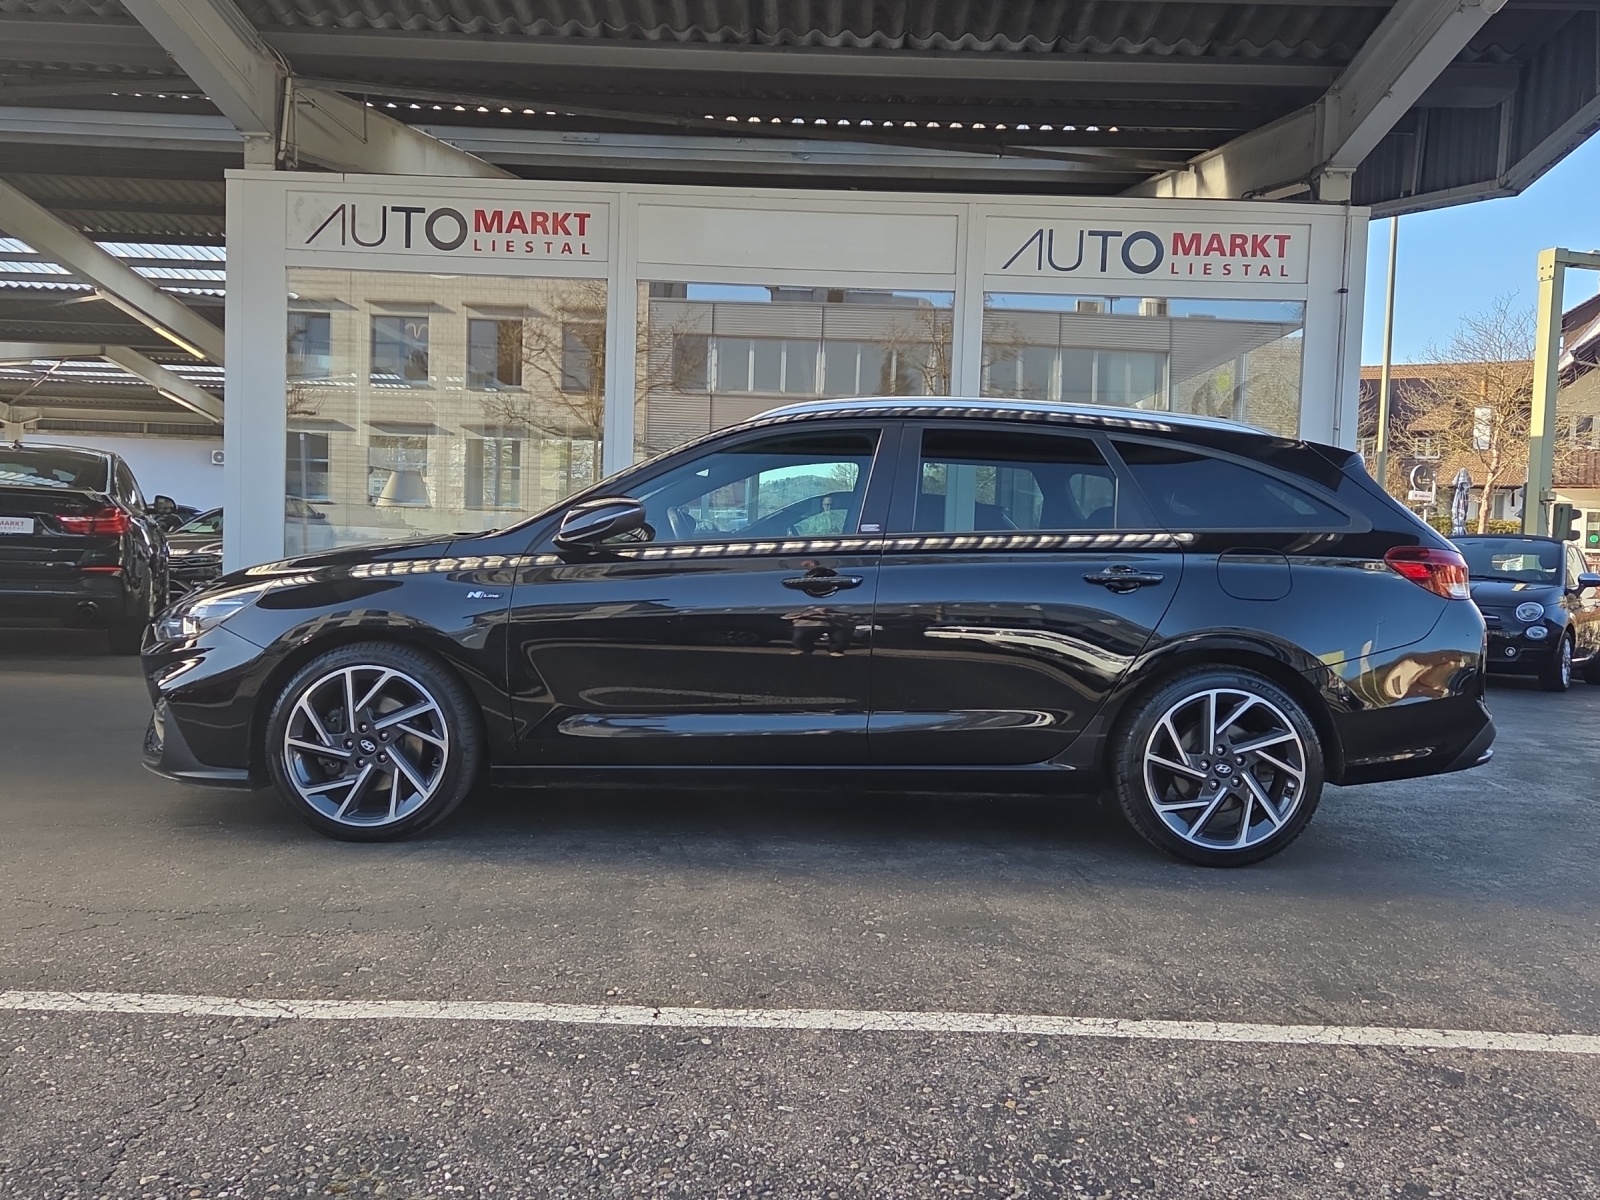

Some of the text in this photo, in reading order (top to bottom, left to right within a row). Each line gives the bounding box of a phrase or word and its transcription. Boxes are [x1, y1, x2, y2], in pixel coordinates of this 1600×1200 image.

[305, 203, 591, 251] AUTO MARKT
[473, 239, 591, 255] LIESTAL
[1001, 228, 1291, 274] AUTO MARKT
[1170, 262, 1289, 277] LIESTAL
[1250, 682, 1292, 710] MICHELIN
